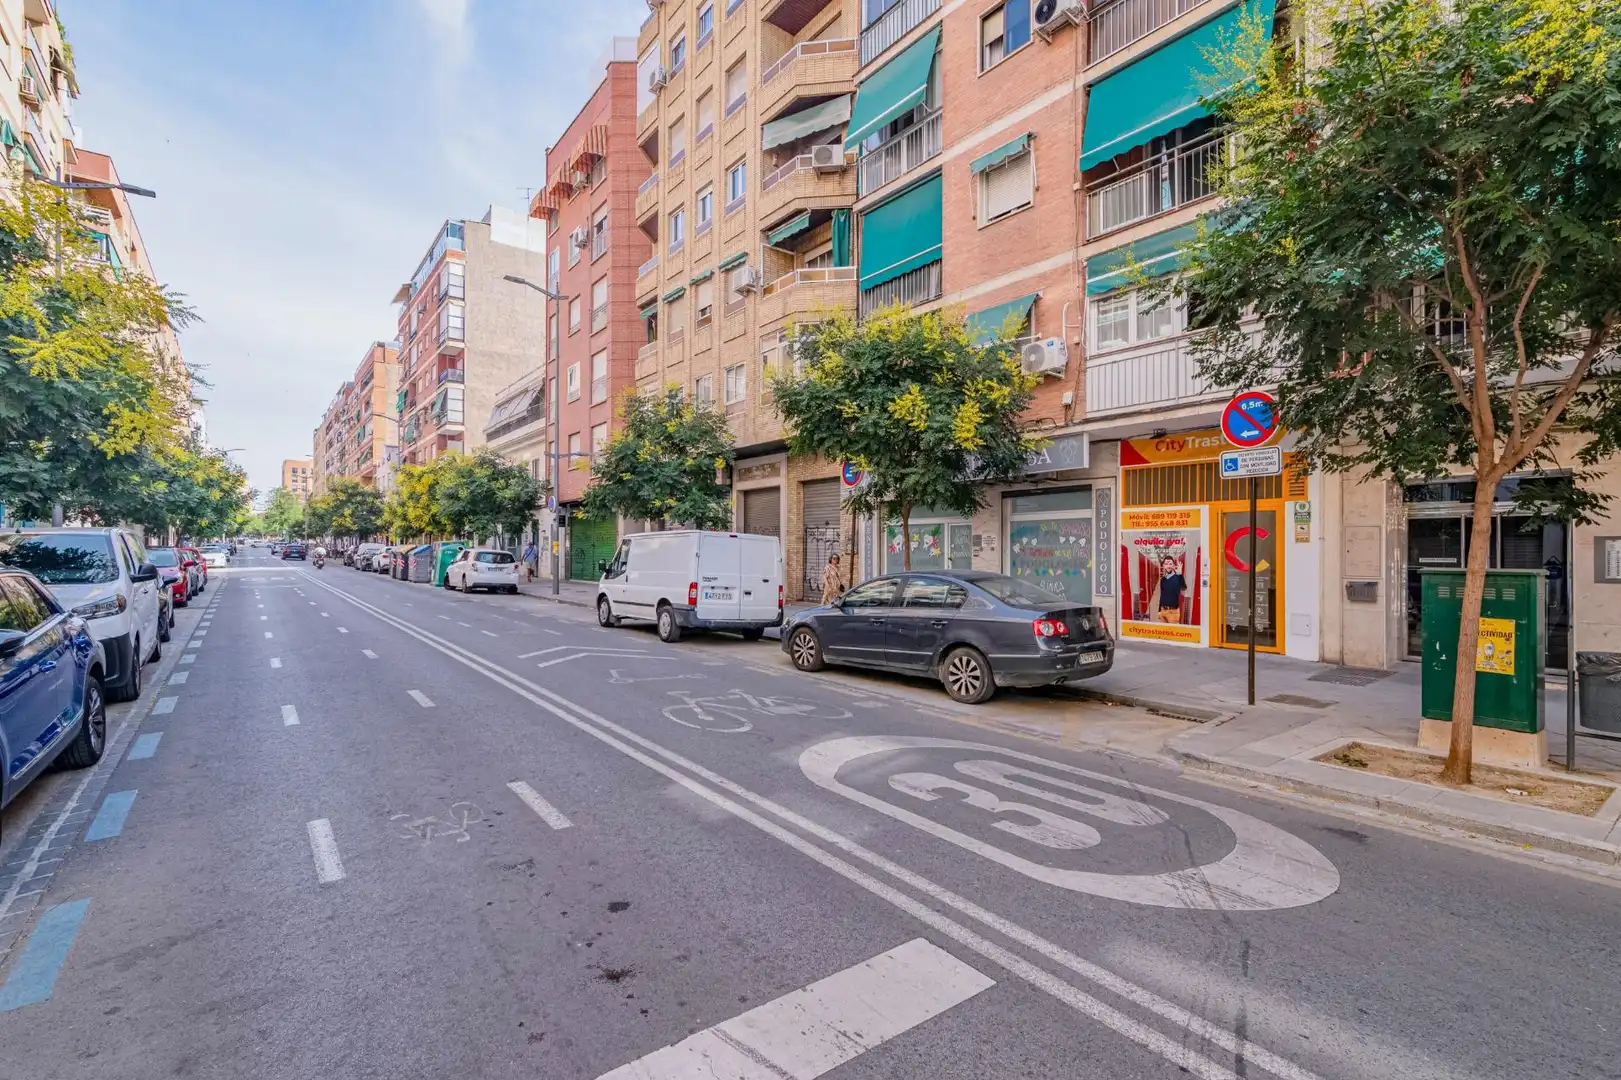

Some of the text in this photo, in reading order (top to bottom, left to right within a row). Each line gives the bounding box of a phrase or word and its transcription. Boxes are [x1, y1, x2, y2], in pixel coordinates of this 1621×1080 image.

[1155, 434, 1227, 452] CityTrast
[1100, 509, 1108, 594] PODOLOGO
[887, 759, 1170, 850] 30
